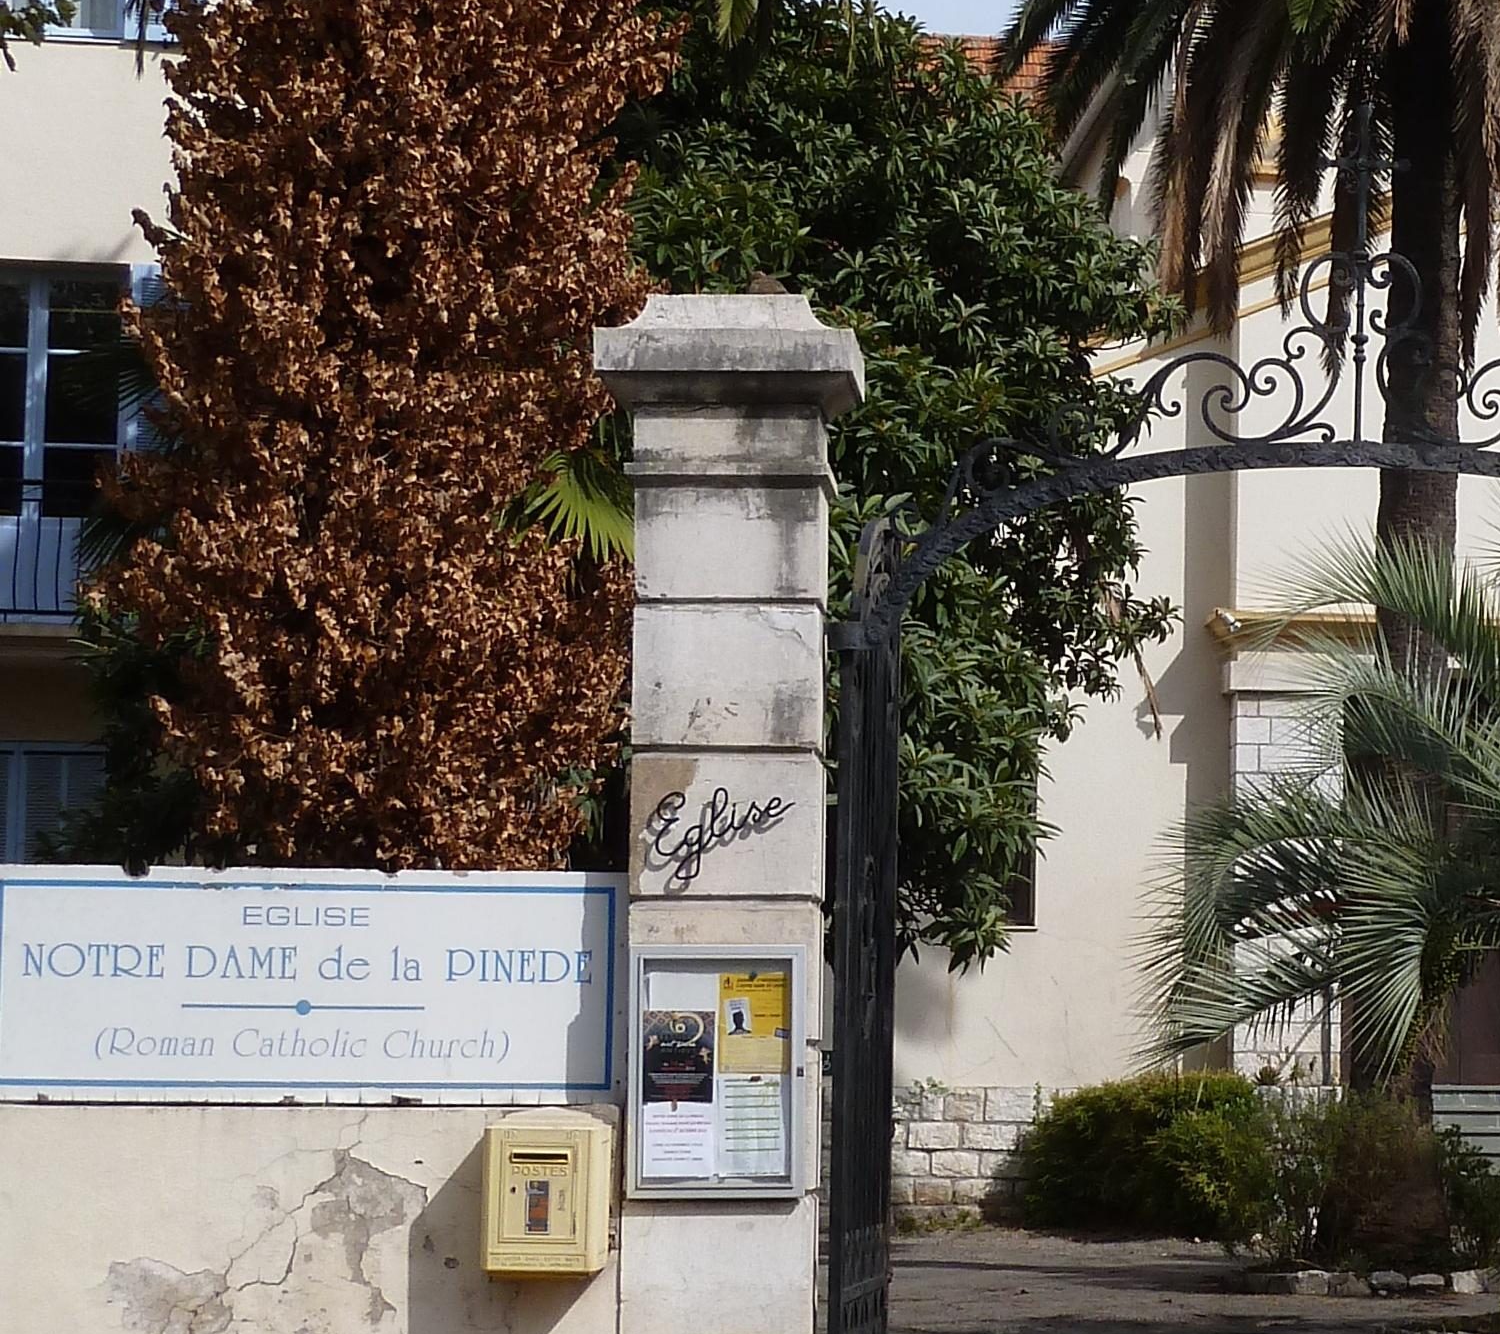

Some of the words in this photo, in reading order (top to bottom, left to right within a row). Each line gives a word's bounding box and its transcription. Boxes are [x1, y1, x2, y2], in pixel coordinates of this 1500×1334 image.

[654, 787, 796, 880] Eglise
[242, 905, 371, 928] EGLISE
[22, 943, 166, 979] NOTRE
[185, 945, 298, 981] DAME
[318, 945, 371, 982] de
[391, 946, 423, 982] la
[445, 948, 593, 985] PINEDE
[94, 1027, 215, 1061] (Roman
[232, 1028, 367, 1060] Catholic
[383, 1028, 512, 1064] Church)
[511, 1165, 569, 1178] POSTES
